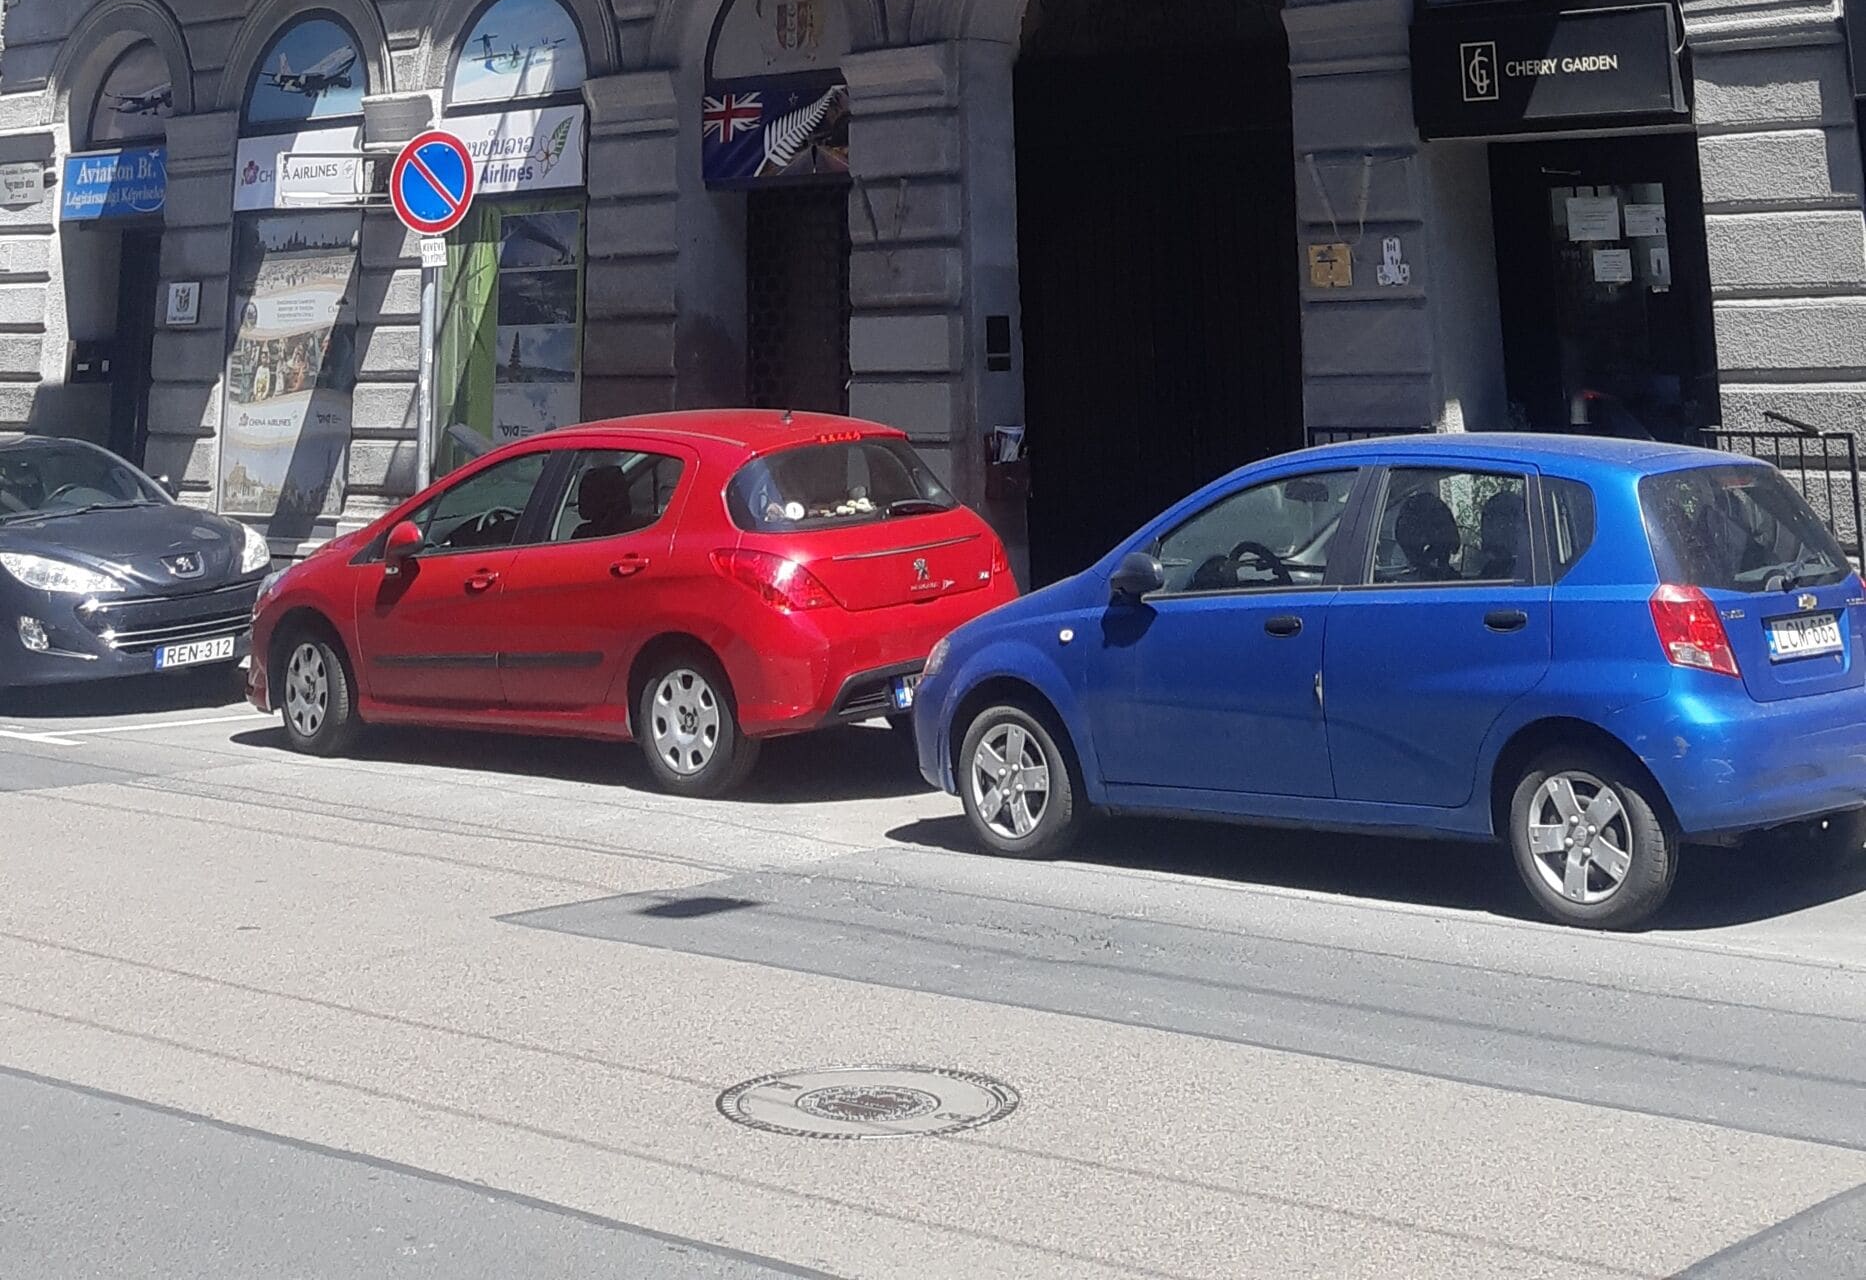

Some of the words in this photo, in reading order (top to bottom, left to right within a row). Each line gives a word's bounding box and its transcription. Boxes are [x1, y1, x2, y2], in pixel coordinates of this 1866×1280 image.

[1506, 58, 1558, 77] CHERRY
[1561, 54, 1618, 73] GARDEN
[76, 159, 134, 185] Aviation
[137, 156, 157, 179] Bt.
[258, 167, 291, 183] CHA
[292, 163, 338, 181] AIRLINES
[480, 164, 533, 184] Airlines
[167, 639, 231, 664] REN-312
